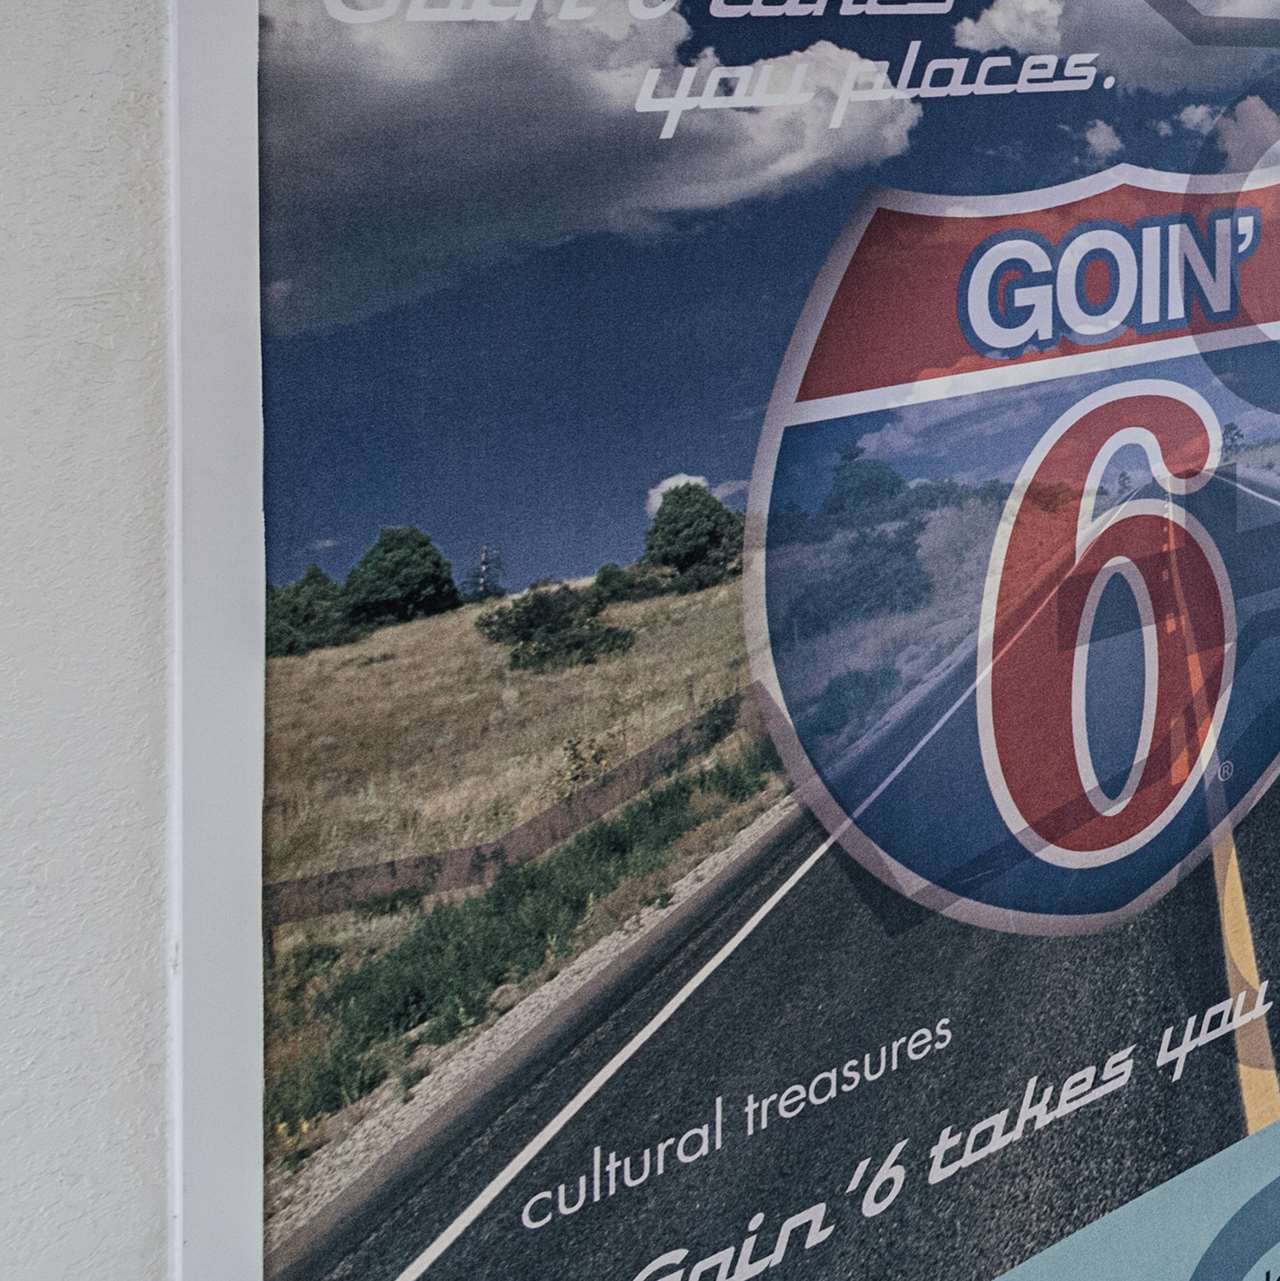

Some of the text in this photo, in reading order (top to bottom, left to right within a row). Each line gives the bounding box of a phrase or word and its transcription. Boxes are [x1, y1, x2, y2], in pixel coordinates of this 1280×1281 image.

[634, 40, 1116, 140] you places.
[966, 215, 1260, 356] GOIN'
[975, 378, 1240, 870] 6
[521, 1017, 952, 1228] cultural treasures
[928, 1045, 1137, 1184] takes
[1157, 978, 1273, 1081] you
